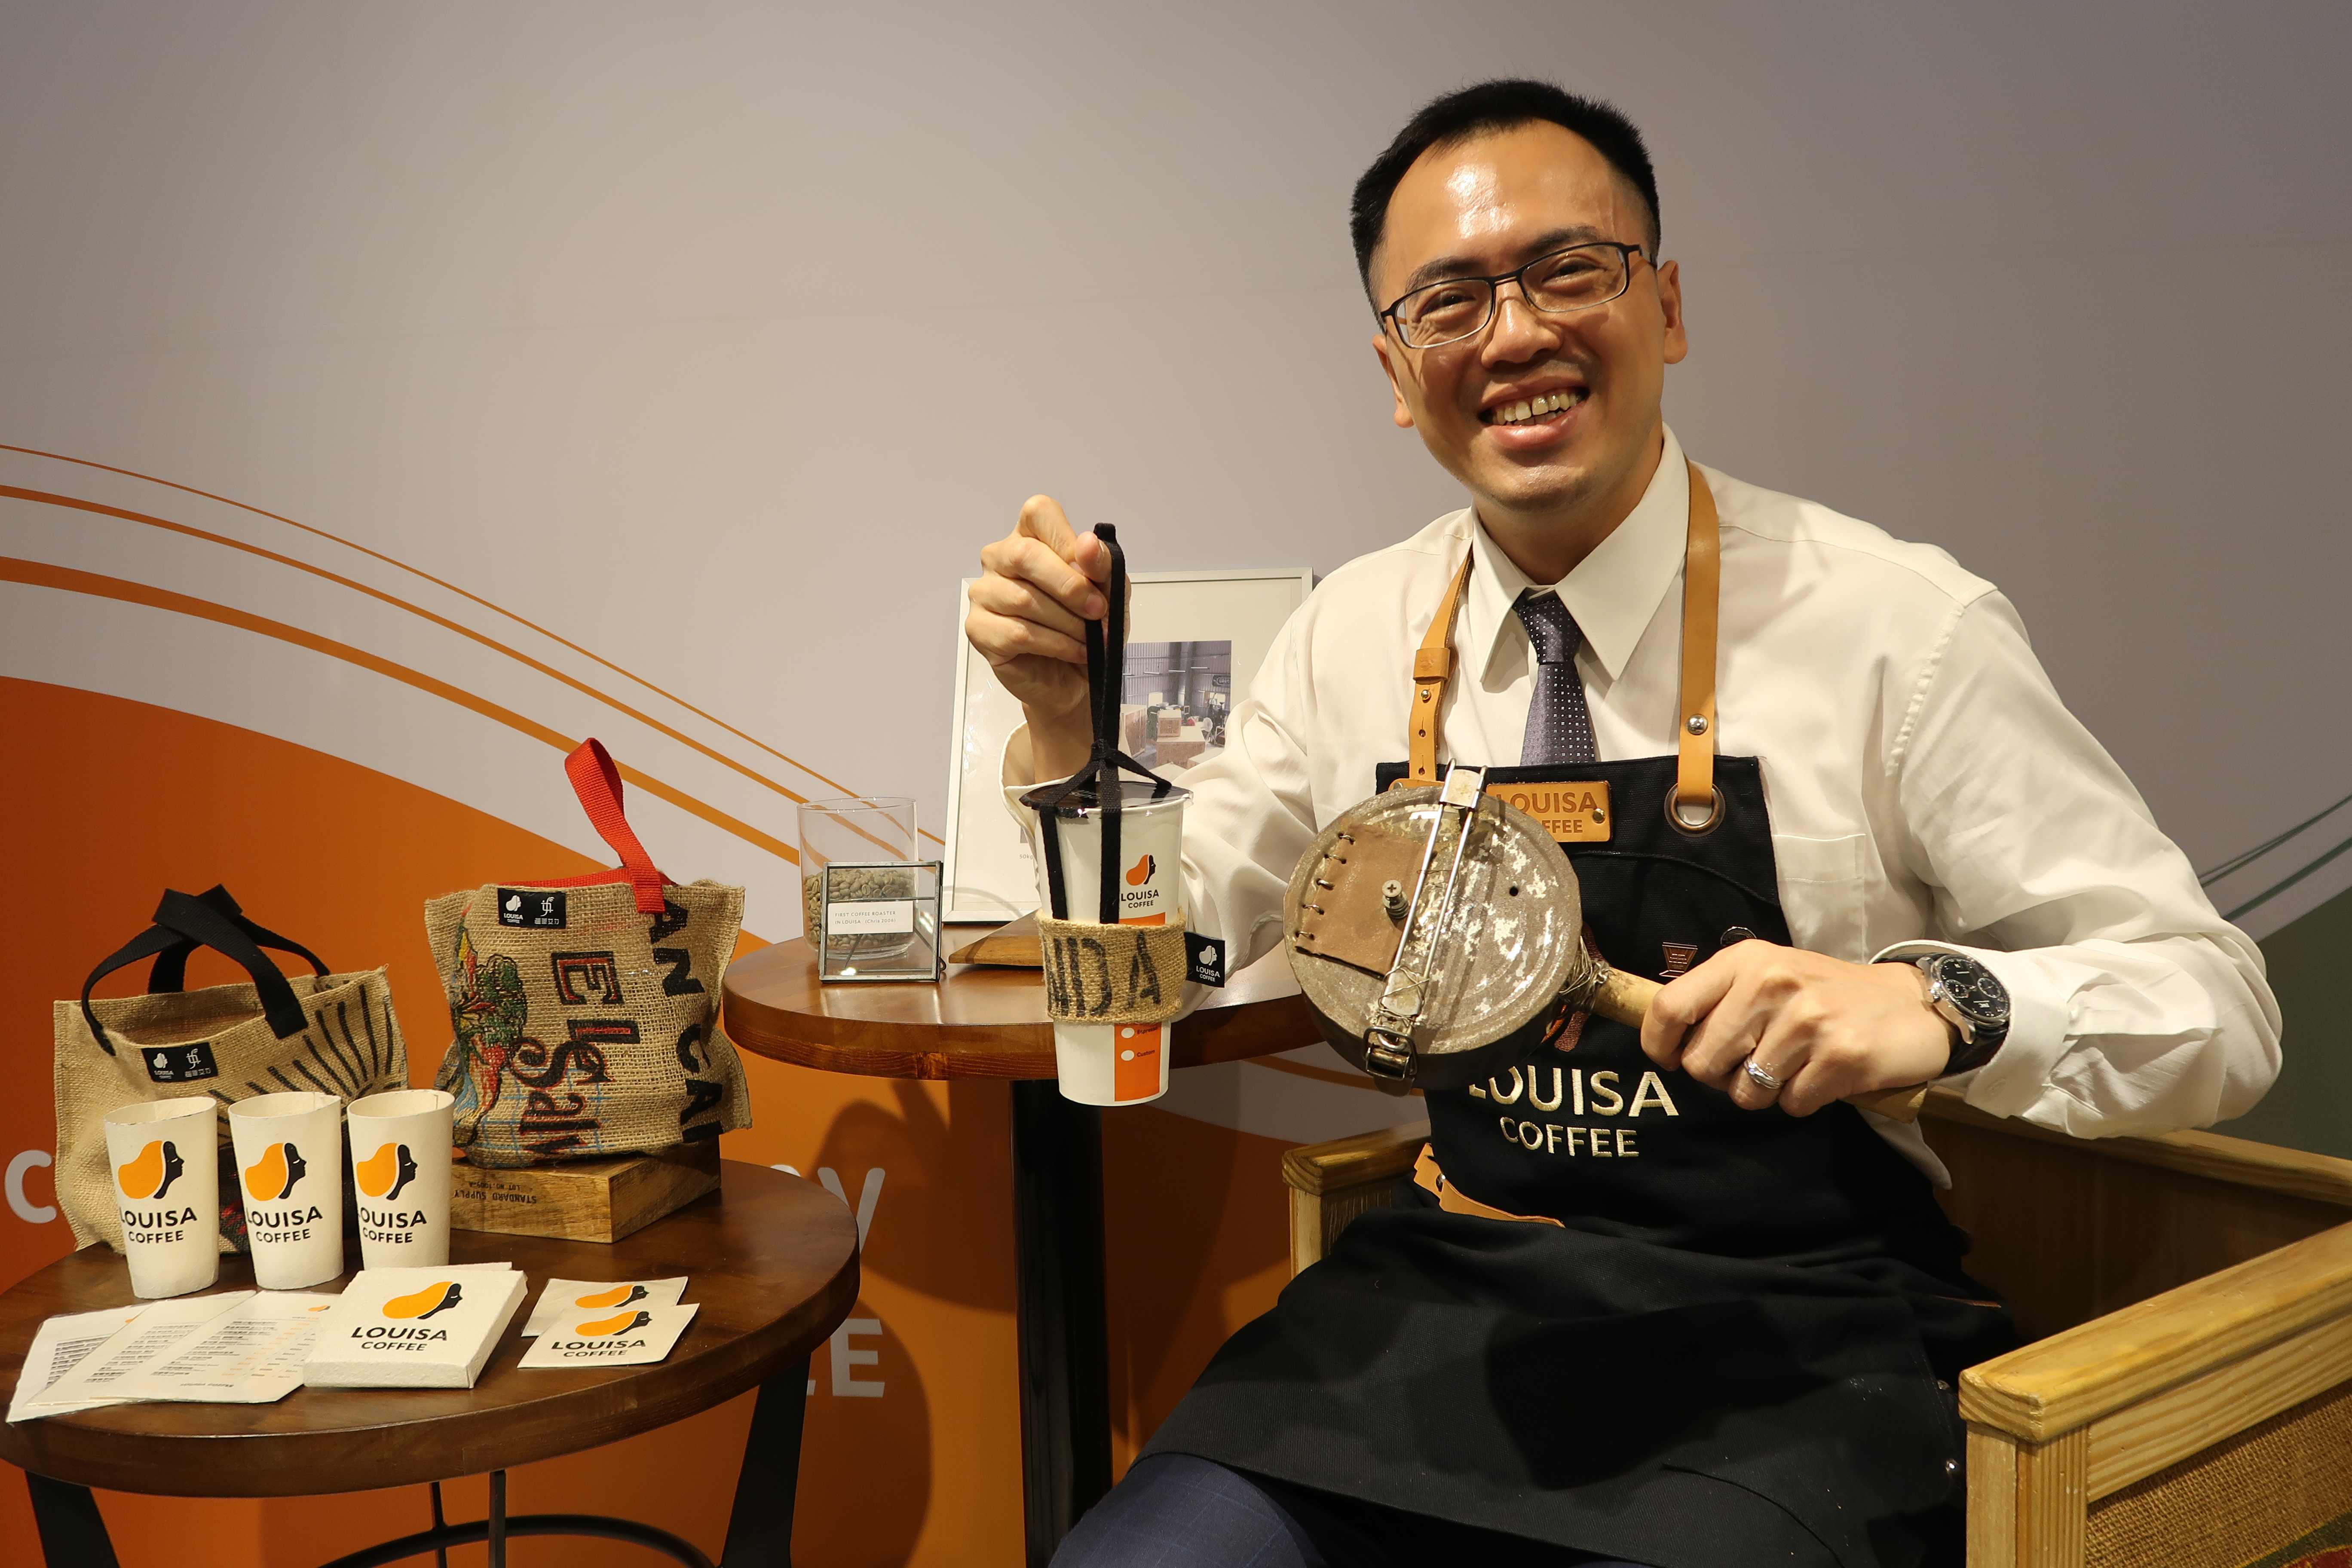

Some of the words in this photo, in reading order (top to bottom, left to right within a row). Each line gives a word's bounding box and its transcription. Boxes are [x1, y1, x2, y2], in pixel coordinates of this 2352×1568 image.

[1497, 792, 1598, 813] OUISA
[1121, 889, 1159, 901] LOUISA
[1128, 900, 1154, 908] COFFEE
[1196, 965, 1220, 978] LOUISA
[1200, 974, 1216, 982] COFFEE
[1500, 1117, 1639, 1157] COFFEE
[454, 1189, 487, 1200] SUPPLY
[492, 1192, 537, 1204] STANDARD
[119, 1207, 198, 1228] LOUISA
[360, 1207, 427, 1228] OUISA
[129, 1230, 184, 1243] COFFEE
[256, 1228, 311, 1243] COFFEE
[363, 1227, 413, 1243] COFFEE
[350, 1326, 447, 1341] LOUISA
[361, 1341, 428, 1351] COFFEE
[551, 1339, 646, 1350] LOUISA
